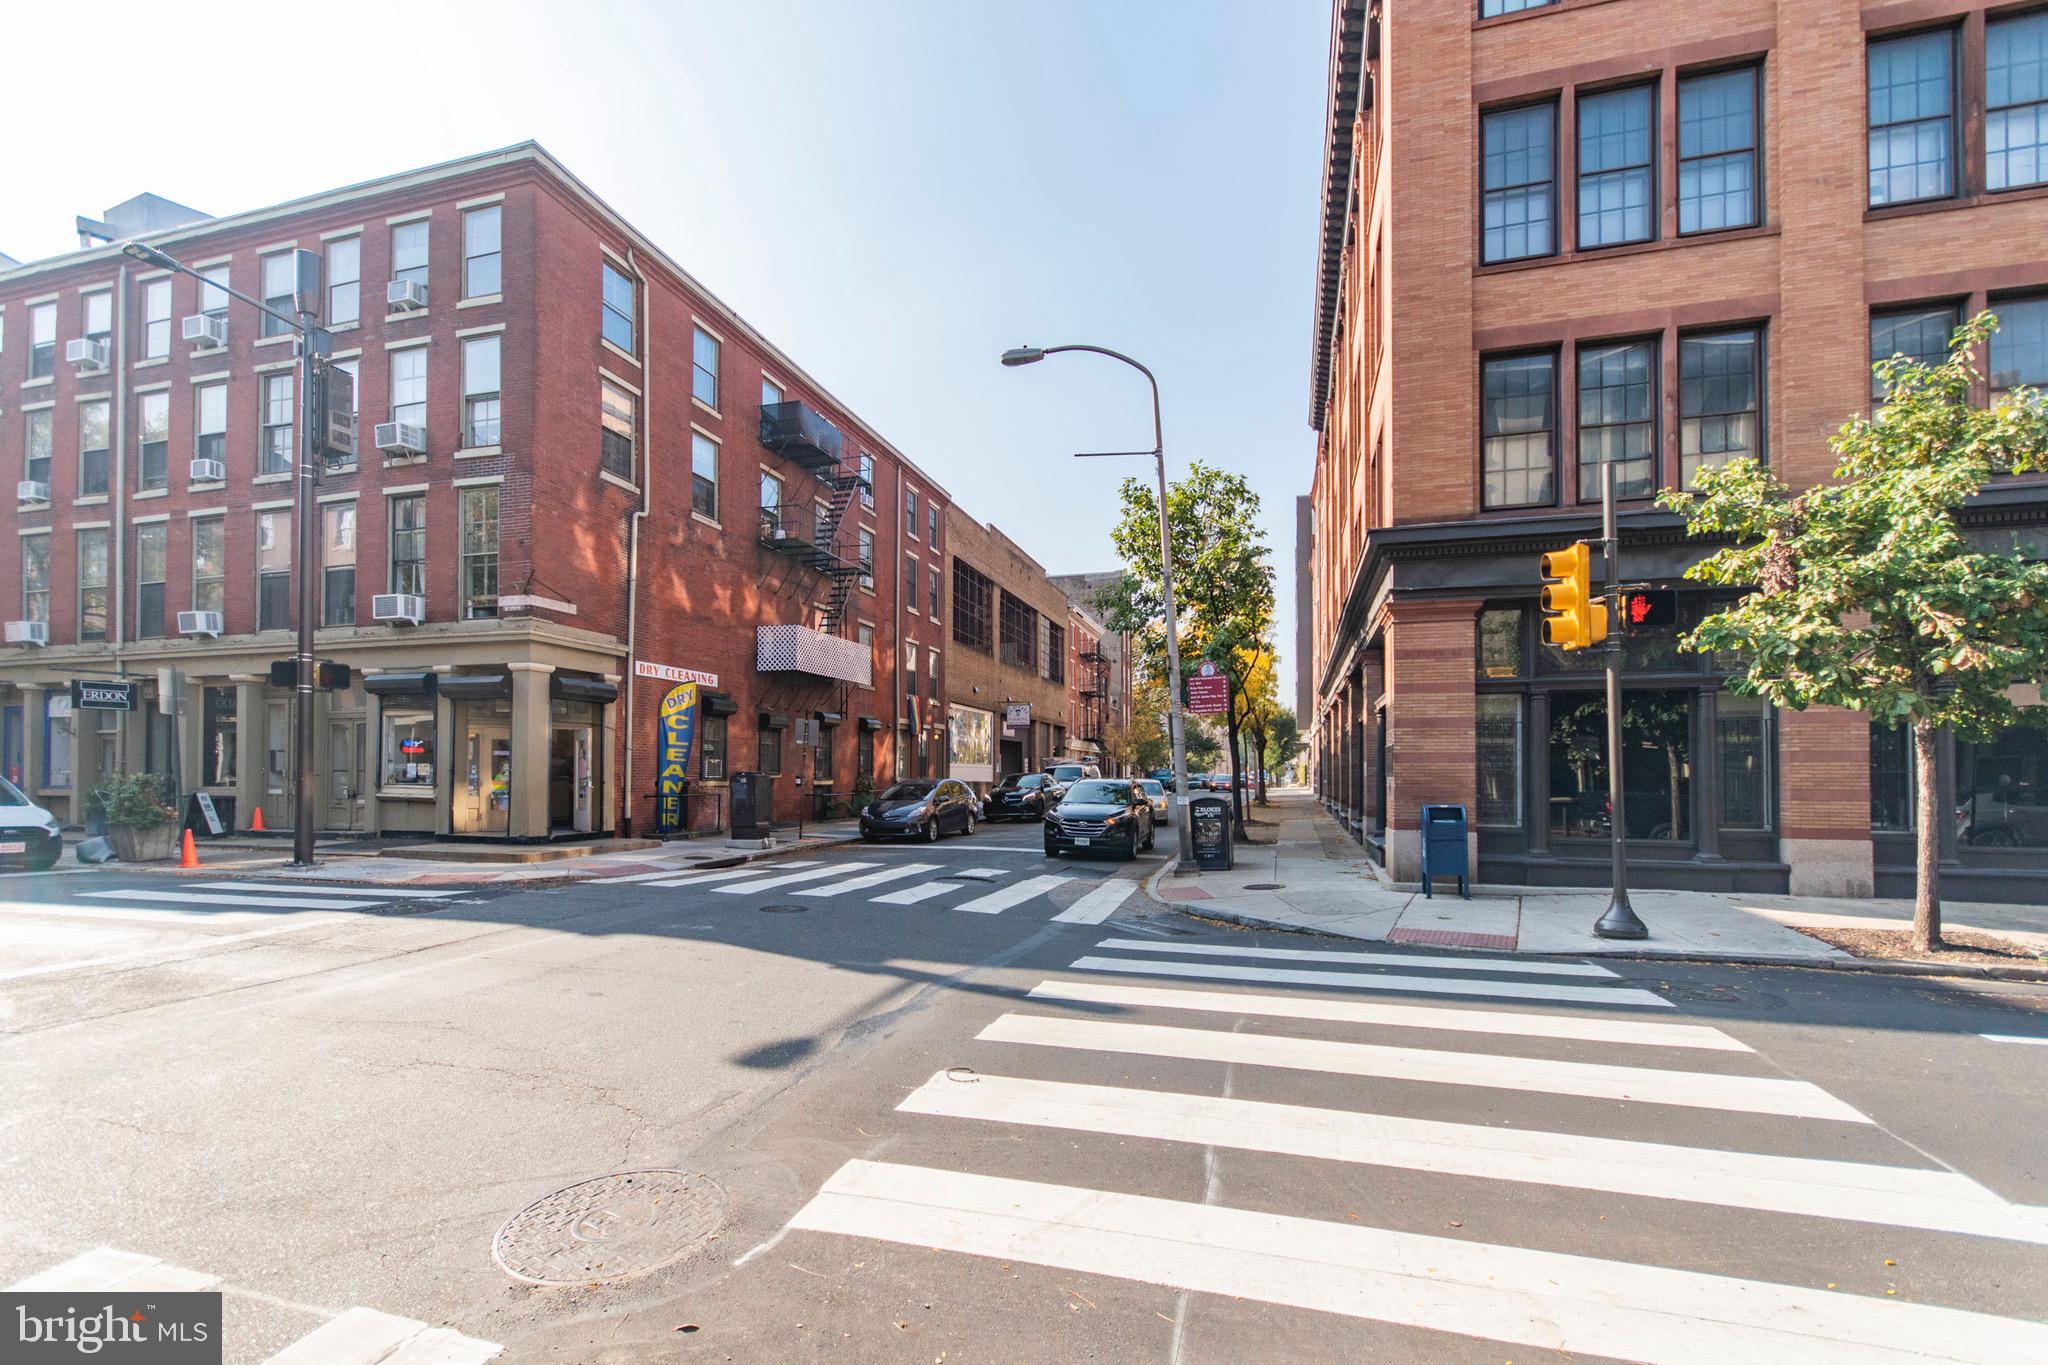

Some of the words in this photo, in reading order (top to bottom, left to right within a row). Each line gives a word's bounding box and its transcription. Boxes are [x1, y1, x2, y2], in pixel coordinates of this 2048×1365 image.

[640, 663, 660, 676] DRY
[665, 667, 715, 685] CLEANING
[83, 690, 127, 701] ERDON
[666, 689, 693, 709] DRY
[662, 715, 688, 826] CLEANER
